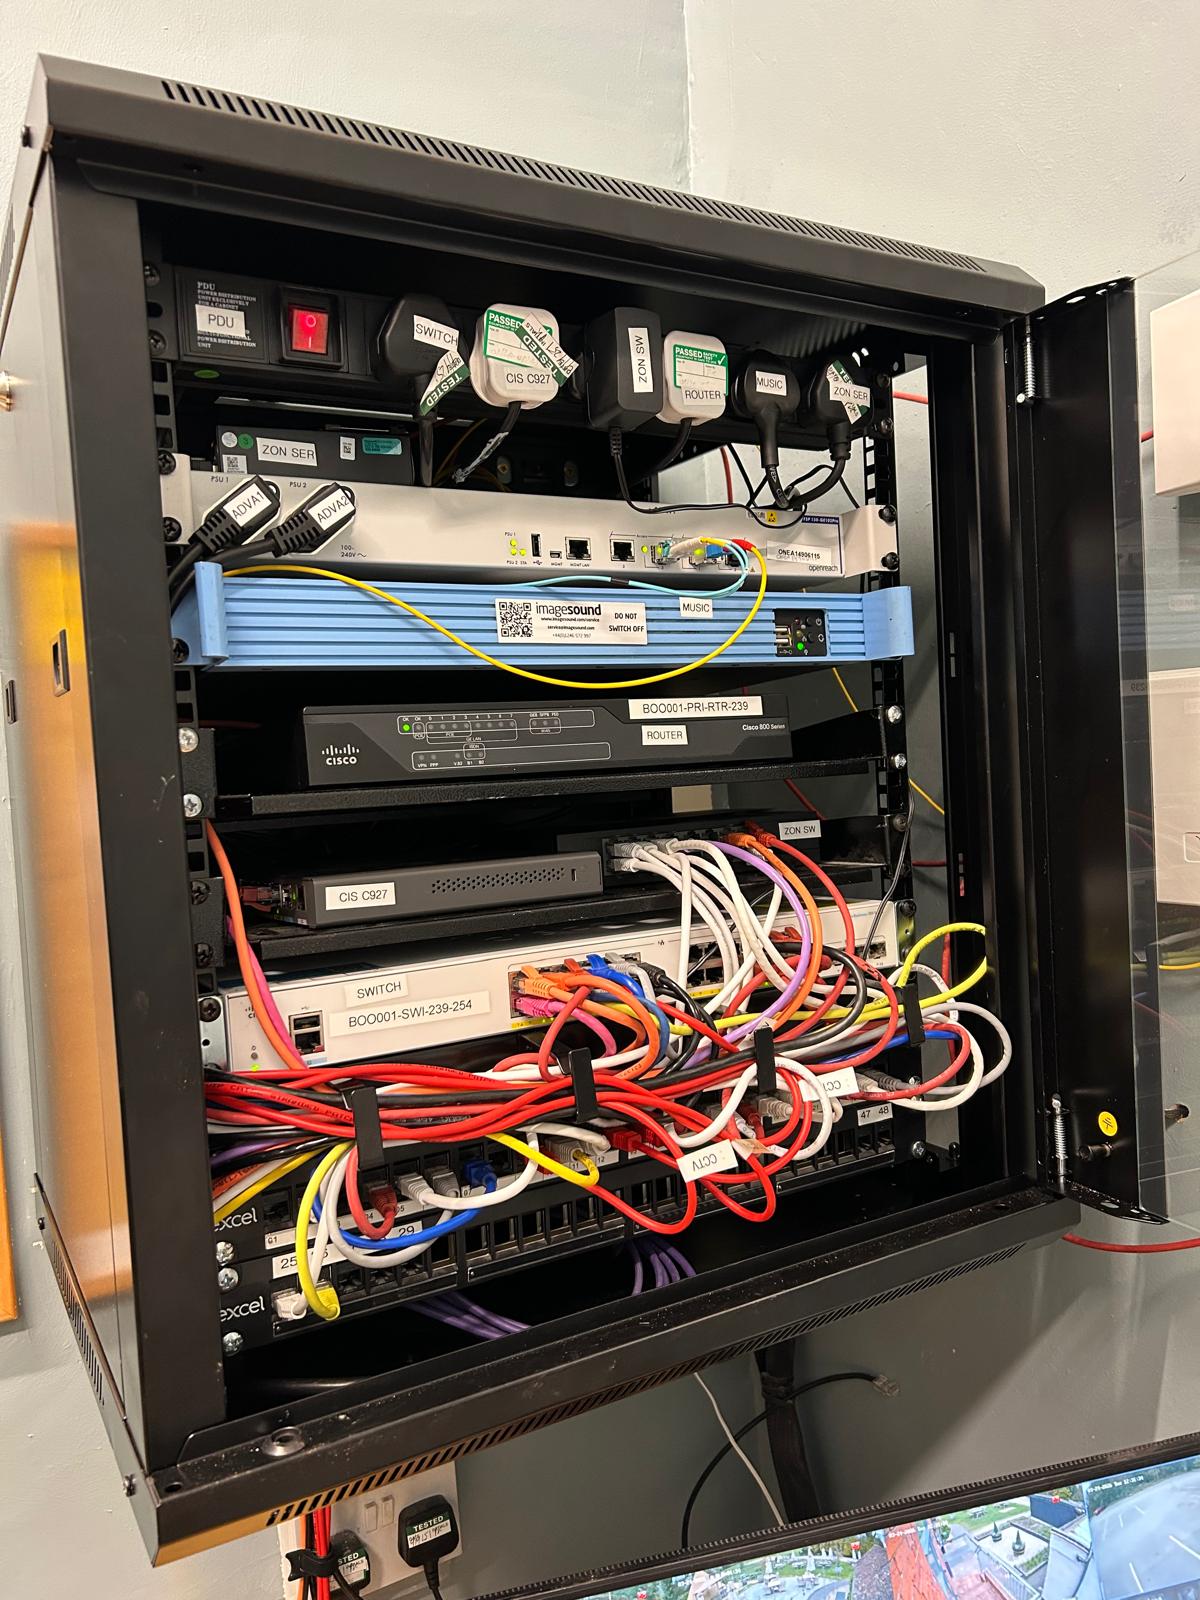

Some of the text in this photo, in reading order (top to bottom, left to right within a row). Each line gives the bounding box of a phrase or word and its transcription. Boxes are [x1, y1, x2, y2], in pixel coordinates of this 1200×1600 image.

[197, 281, 216, 291] PDU
[208, 313, 234, 329] PDU
[489, 312, 522, 329] PASSED
[415, 323, 458, 346] SWITCH
[522, 335, 558, 377] TESTED
[675, 346, 703, 359] PASSED
[634, 335, 648, 384] ZON SW
[506, 373, 551, 384] CIS C927
[756, 377, 783, 390] MUSIC
[426, 373, 463, 407] TESTED
[684, 389, 721, 400] ROUTER
[833, 386, 868, 400] ZON SER
[262, 444, 315, 460] ZON SER
[211, 475, 225, 483] PSU
[231, 490, 265, 520] ADVA1
[317, 495, 350, 523] ADVA2
[808, 564, 839, 572] openreach
[535, 602, 602, 617] imagesound
[682, 603, 710, 613] MUSIC
[614, 612, 624, 620] DO
[642, 701, 749, 714] BOO001-PRI-RTR-239
[647, 730, 683, 740] ROUTER
[784, 825, 816, 835] ZON SW
[339, 889, 388, 902] CIS C927
[357, 981, 402, 999] SWITCH
[348, 999, 473, 1028] BOO001-SWI-239-254
[860, 1105, 890, 1119] 47 48
[691, 1153, 718, 1172] CCTV
[398, 1225, 415, 1237] 29
[280, 1256, 298, 1269] 25
[413, 1515, 444, 1532] TESTED
[337, 1552, 359, 1565] STED
